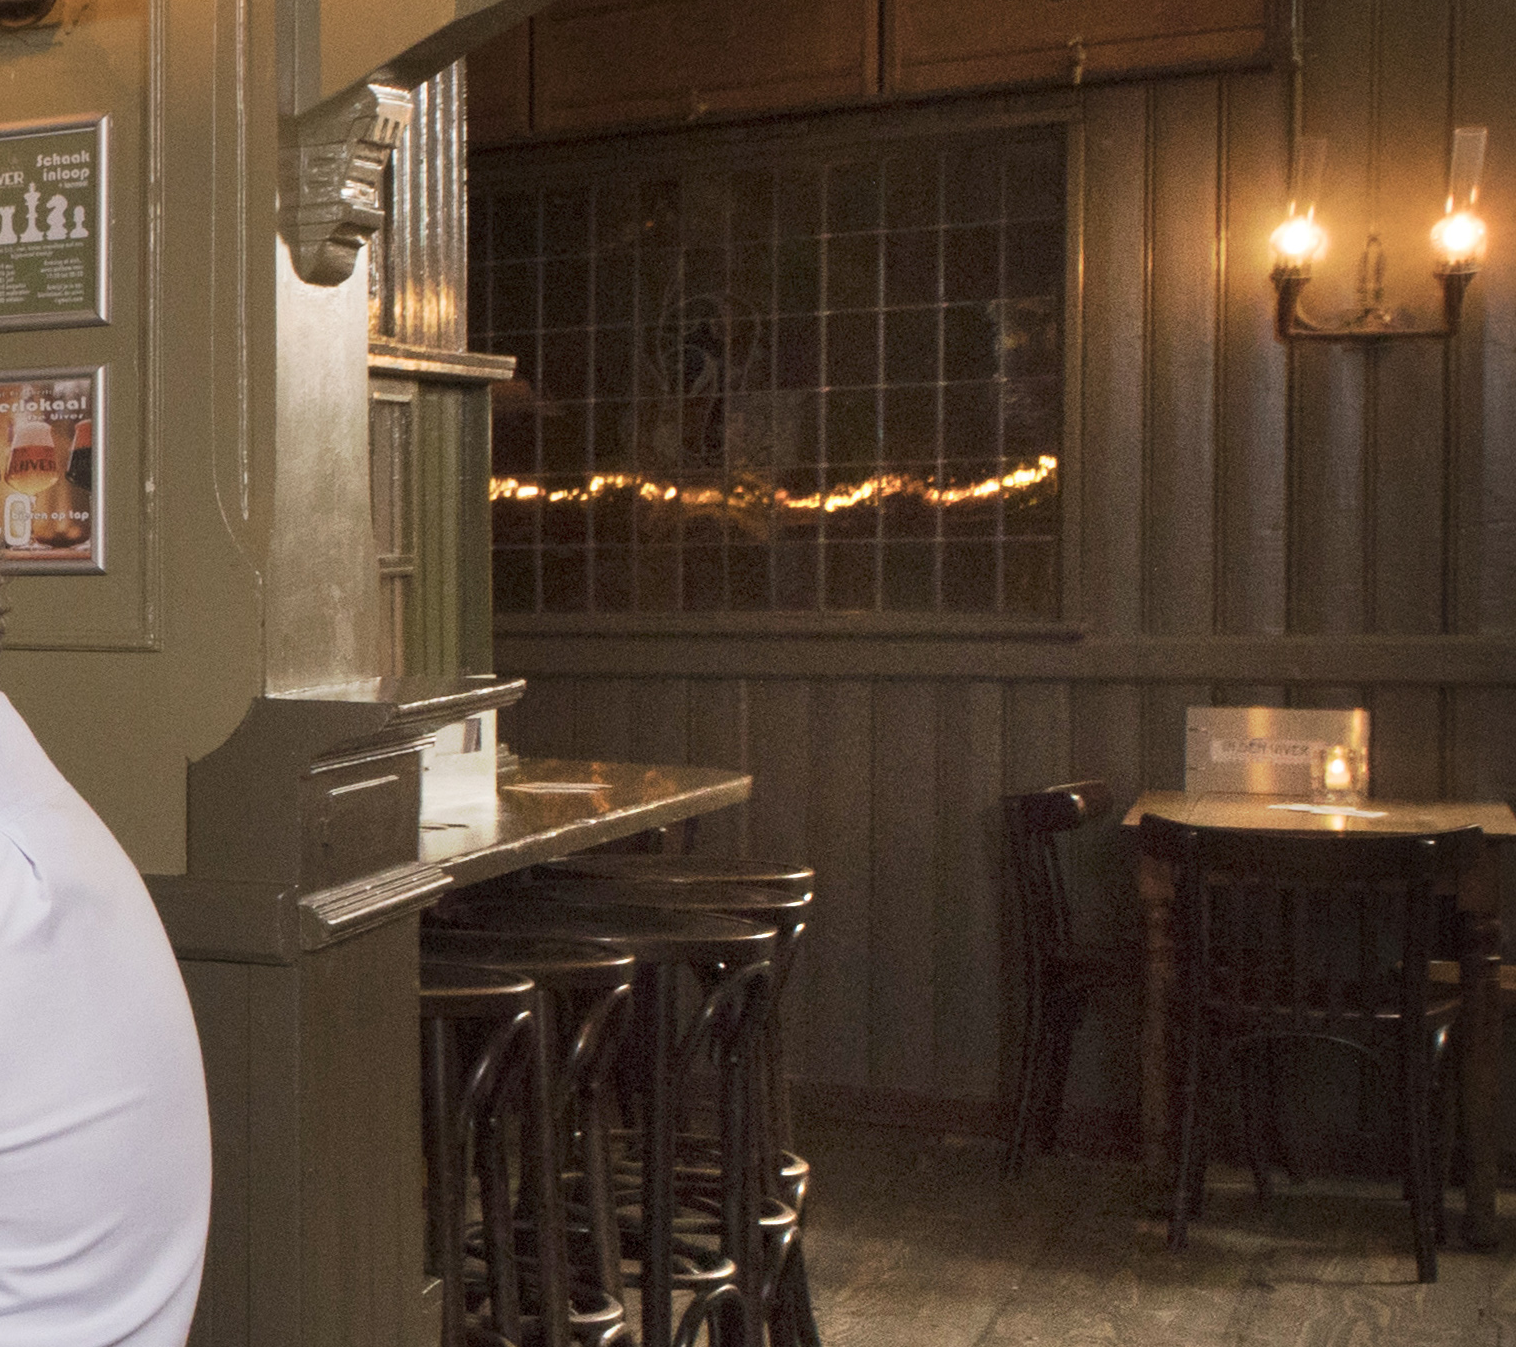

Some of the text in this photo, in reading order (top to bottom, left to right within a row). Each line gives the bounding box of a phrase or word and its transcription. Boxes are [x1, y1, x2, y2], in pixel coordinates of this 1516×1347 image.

[36, 150, 91, 168] Schaak
[43, 167, 90, 182] inloop
[50, 412, 84, 421] Uiver
[51, 511, 66, 521] op
[69, 509, 90, 522] tap
